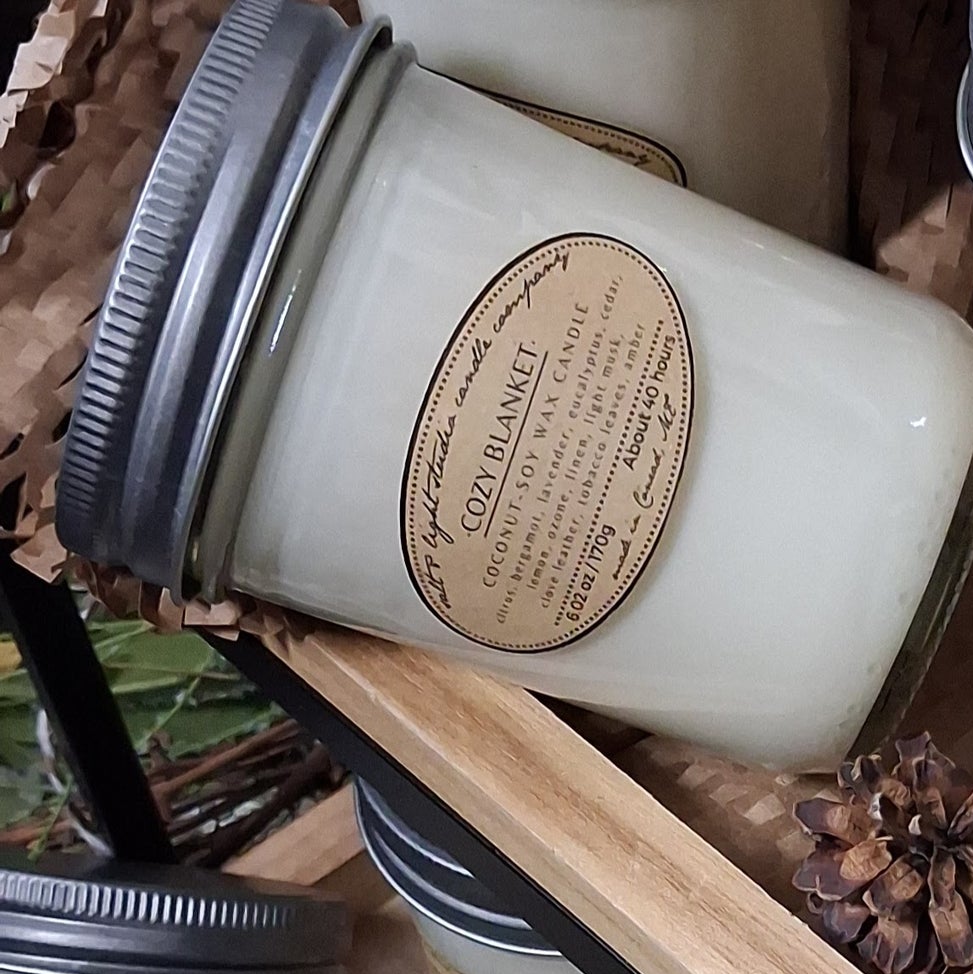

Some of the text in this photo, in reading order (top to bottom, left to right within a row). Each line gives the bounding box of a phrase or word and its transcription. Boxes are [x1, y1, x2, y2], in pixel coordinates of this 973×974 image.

[493, 250, 570, 333] company
[455, 338, 492, 408] candle
[533, 394, 560, 440] WAX
[553, 302, 590, 383] CANDLE
[649, 335, 676, 383] hours
[578, 442, 608, 506] tobacco
[624, 322, 647, 372] amber
[584, 386, 608, 425] light
[642, 385, 660, 411] 40
[427, 415, 456, 488] studio
[622, 412, 652, 471] About
[422, 487, 454, 549] light
[581, 571, 596, 592] oz
